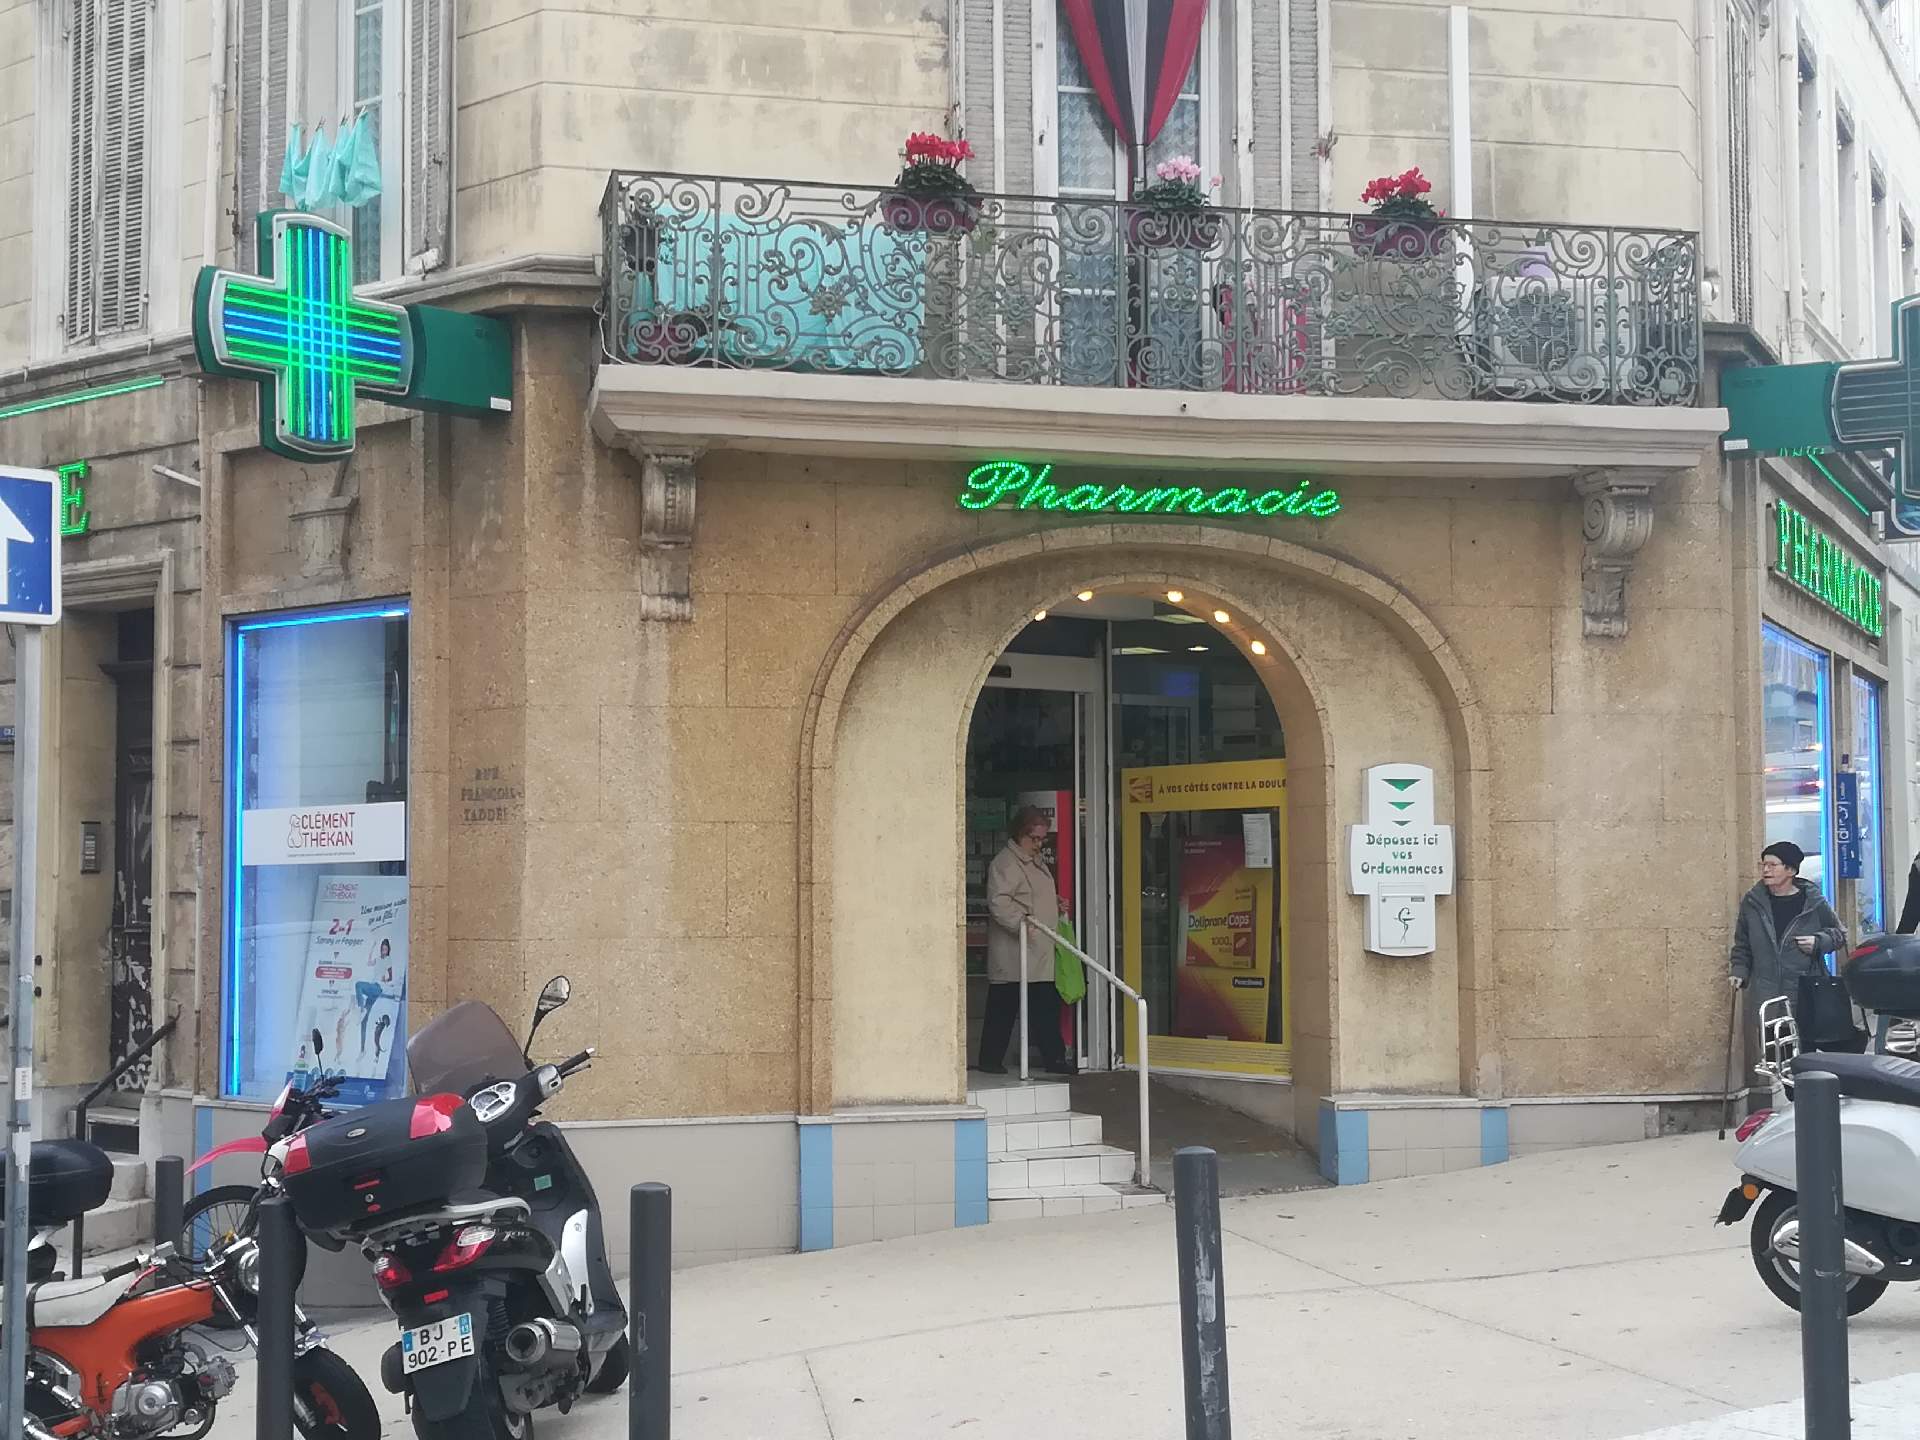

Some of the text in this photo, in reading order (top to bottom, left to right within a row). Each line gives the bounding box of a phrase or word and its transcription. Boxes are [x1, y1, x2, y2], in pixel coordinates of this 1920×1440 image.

[959, 461, 1341, 518] Pharmacie
[1777, 498, 1882, 638] PHARMACIE
[1167, 785, 1182, 793] VOS
[1184, 782, 1209, 793] CÔTÉS
[1211, 781, 1243, 792] CONTRE
[1245, 780, 1257, 790] LA
[301, 811, 355, 829] CLÉMENT
[302, 829, 353, 848] THÉKAN
[1366, 833, 1438, 848] Déposez ici
[1392, 850, 1412, 859] vos
[1361, 862, 1443, 874] Ordonnances
